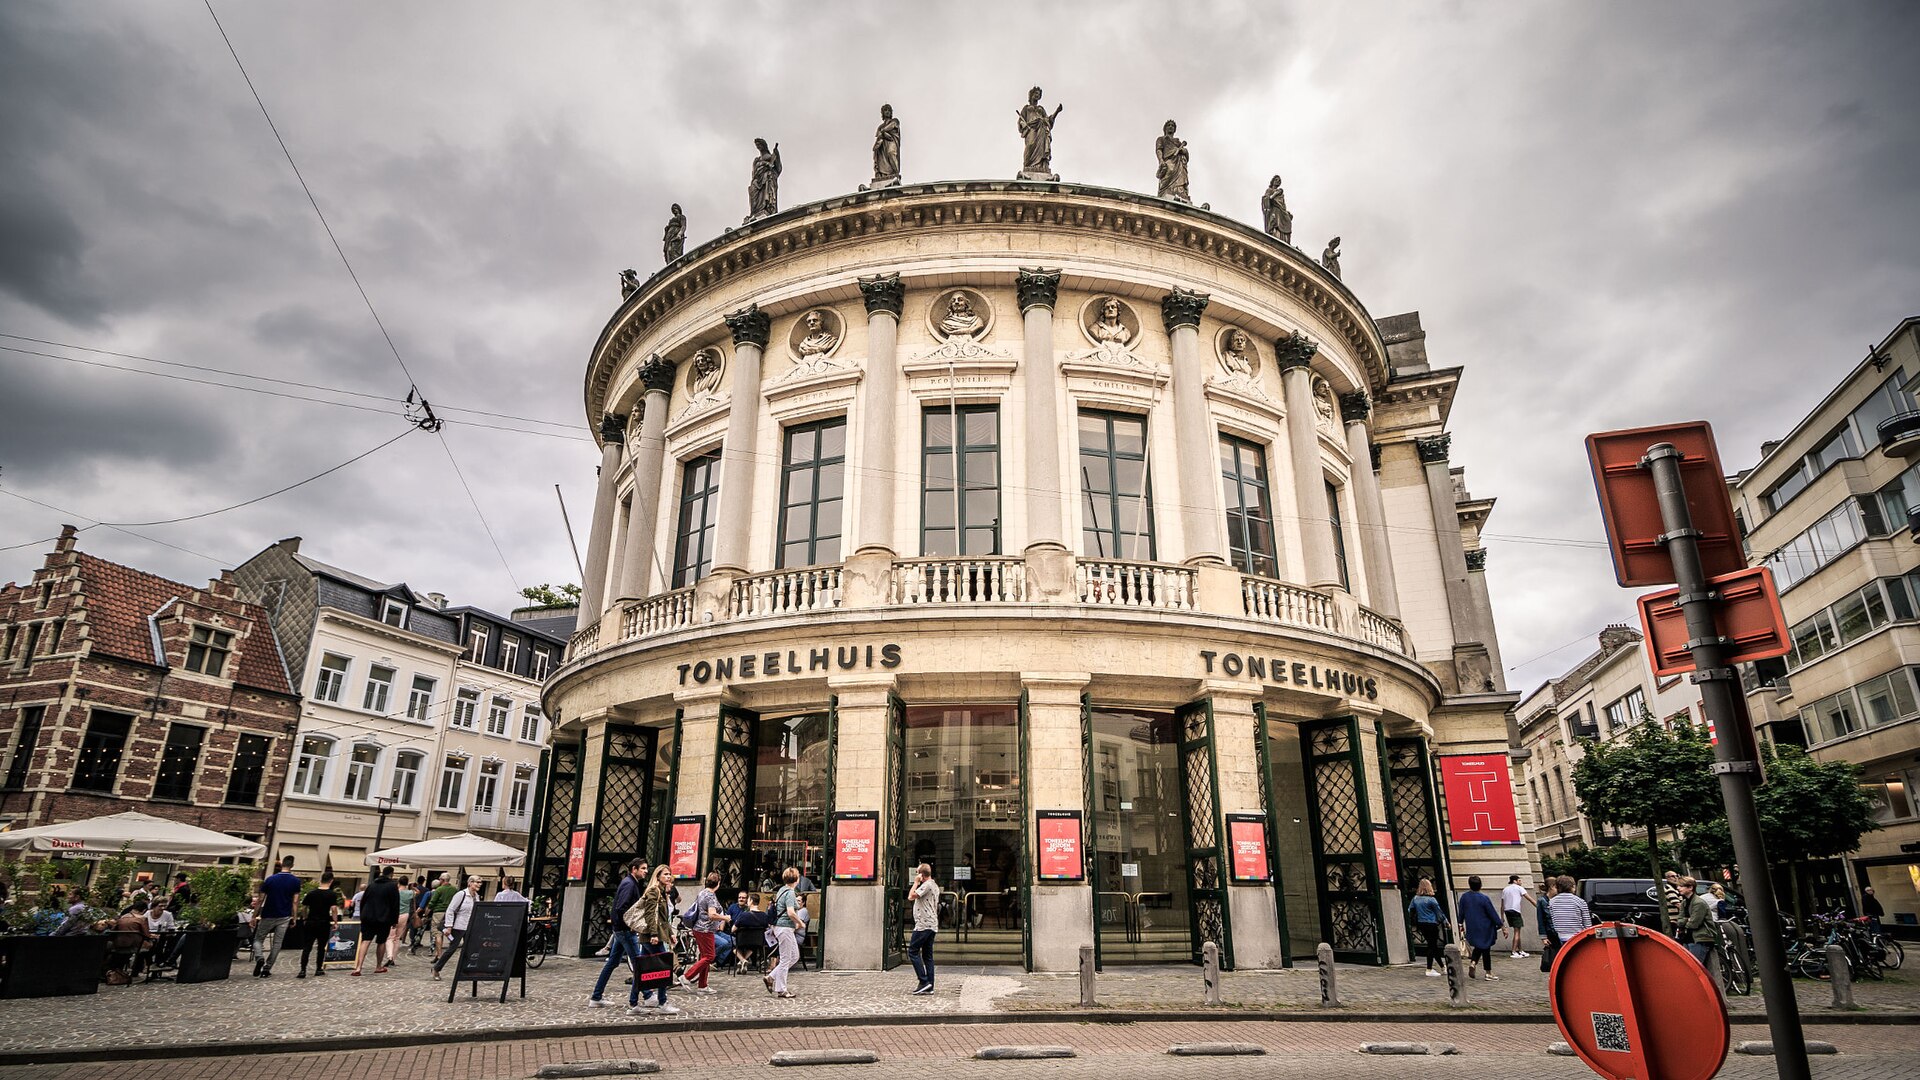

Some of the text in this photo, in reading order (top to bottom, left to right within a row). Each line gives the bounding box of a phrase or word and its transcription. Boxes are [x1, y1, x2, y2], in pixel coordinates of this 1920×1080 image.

[930, 376, 992, 384] P.CONEILLE.
[676, 643, 901, 685] TONEELHUIS
[1200, 650, 1378, 700] TONEELHUIS
[51, 838, 85, 849] Duvel
[378, 856, 400, 864] Duvel
[641, 970, 670, 980] OXFORD
